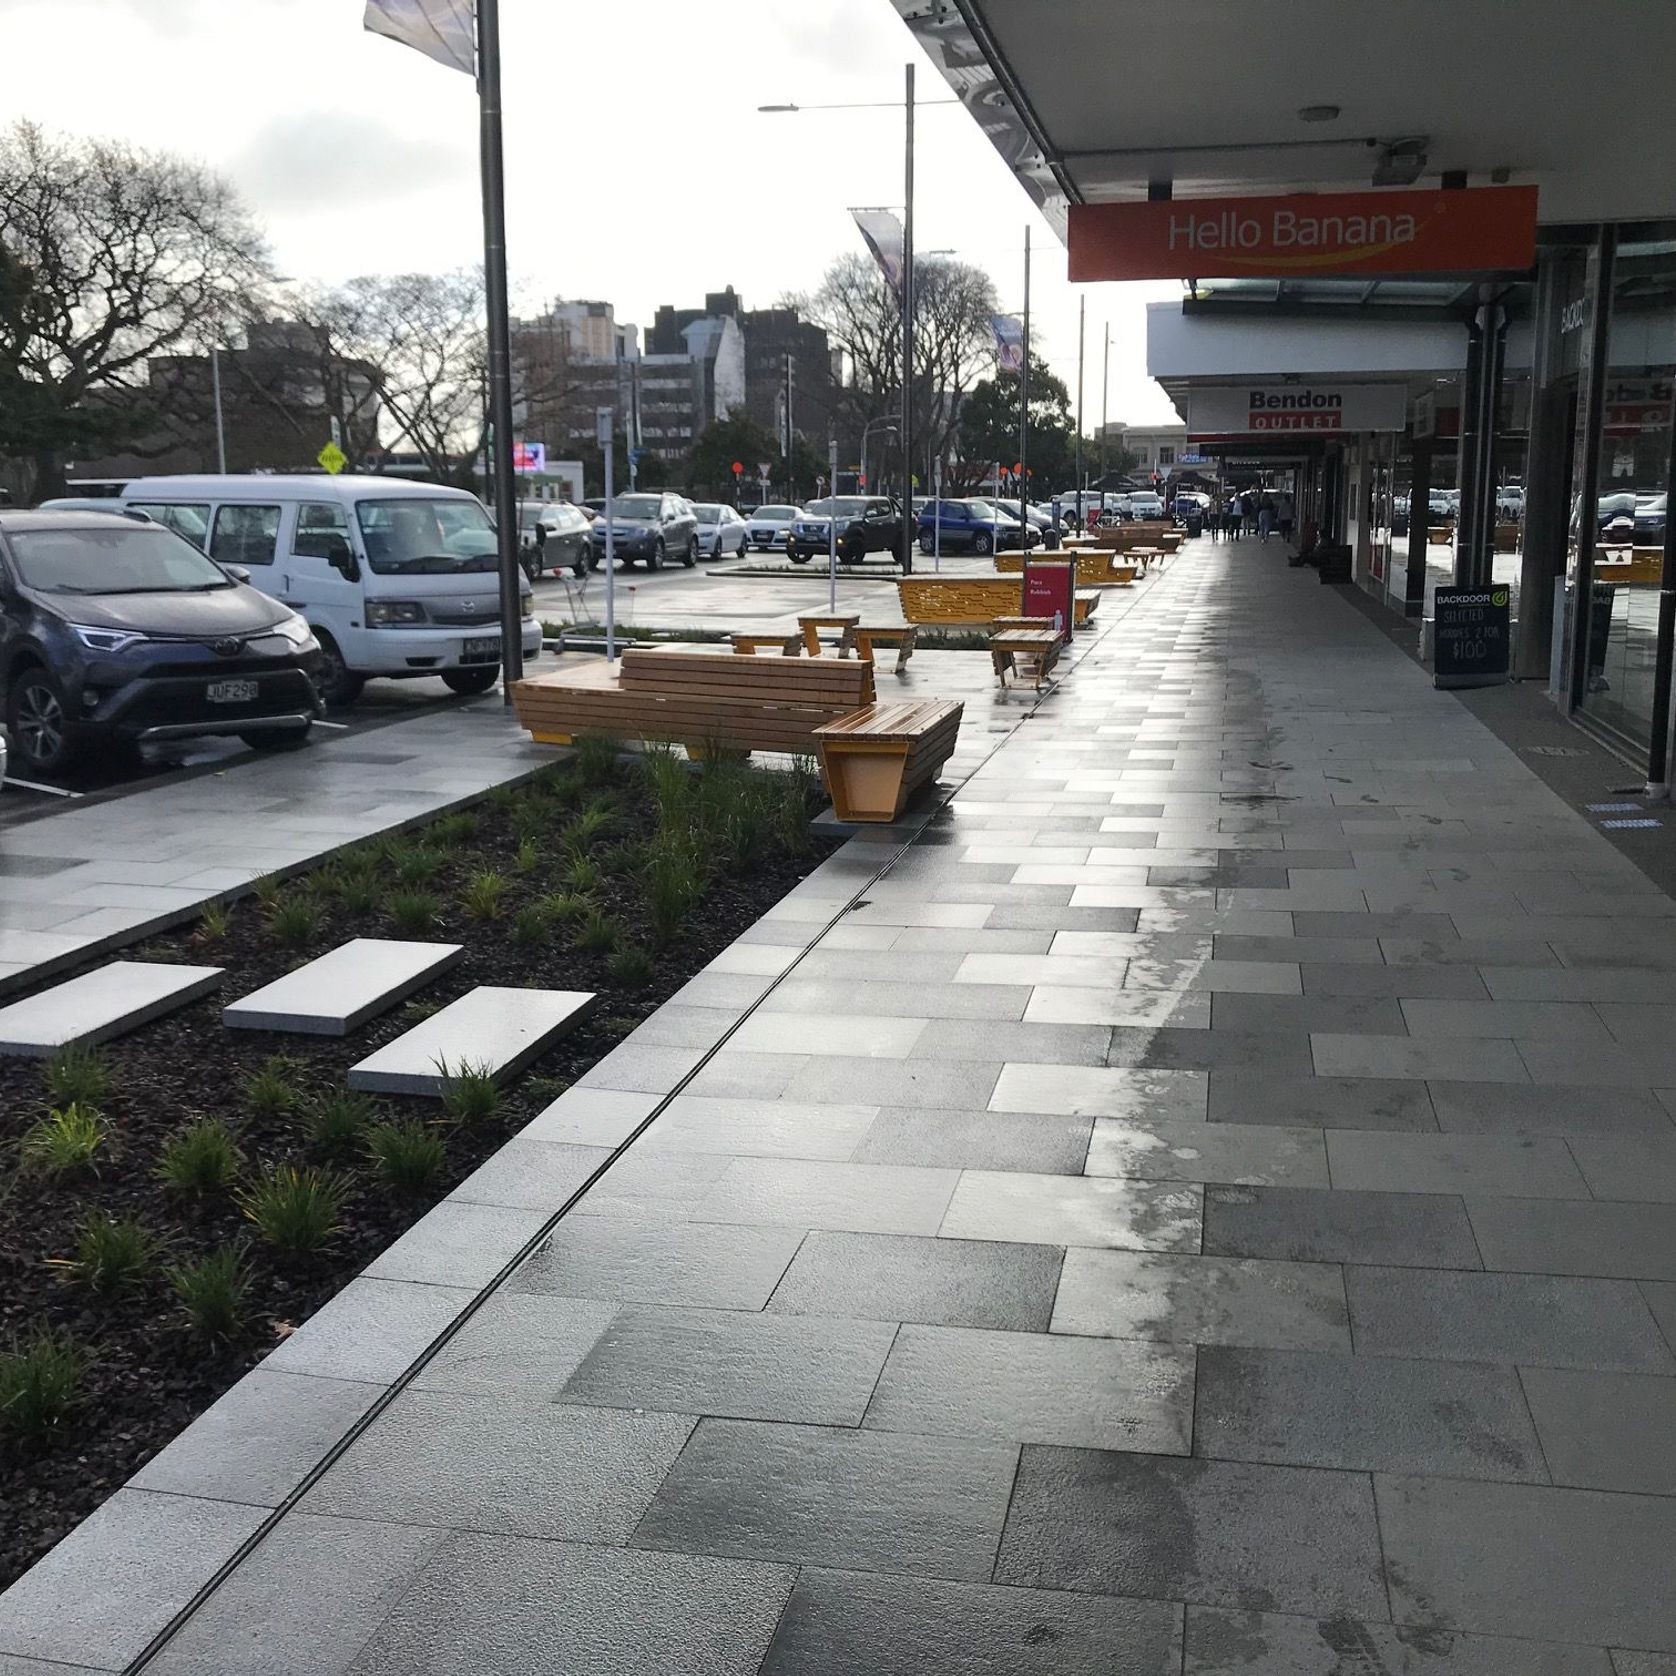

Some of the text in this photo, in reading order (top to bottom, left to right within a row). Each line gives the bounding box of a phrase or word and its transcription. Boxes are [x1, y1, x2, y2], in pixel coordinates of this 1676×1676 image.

[1168, 210, 1416, 250] Hello Banana
[1249, 389, 1342, 409] Bendon
[1255, 415, 1336, 430] OUTLET
[1437, 594, 1490, 604] BACKDOOR
